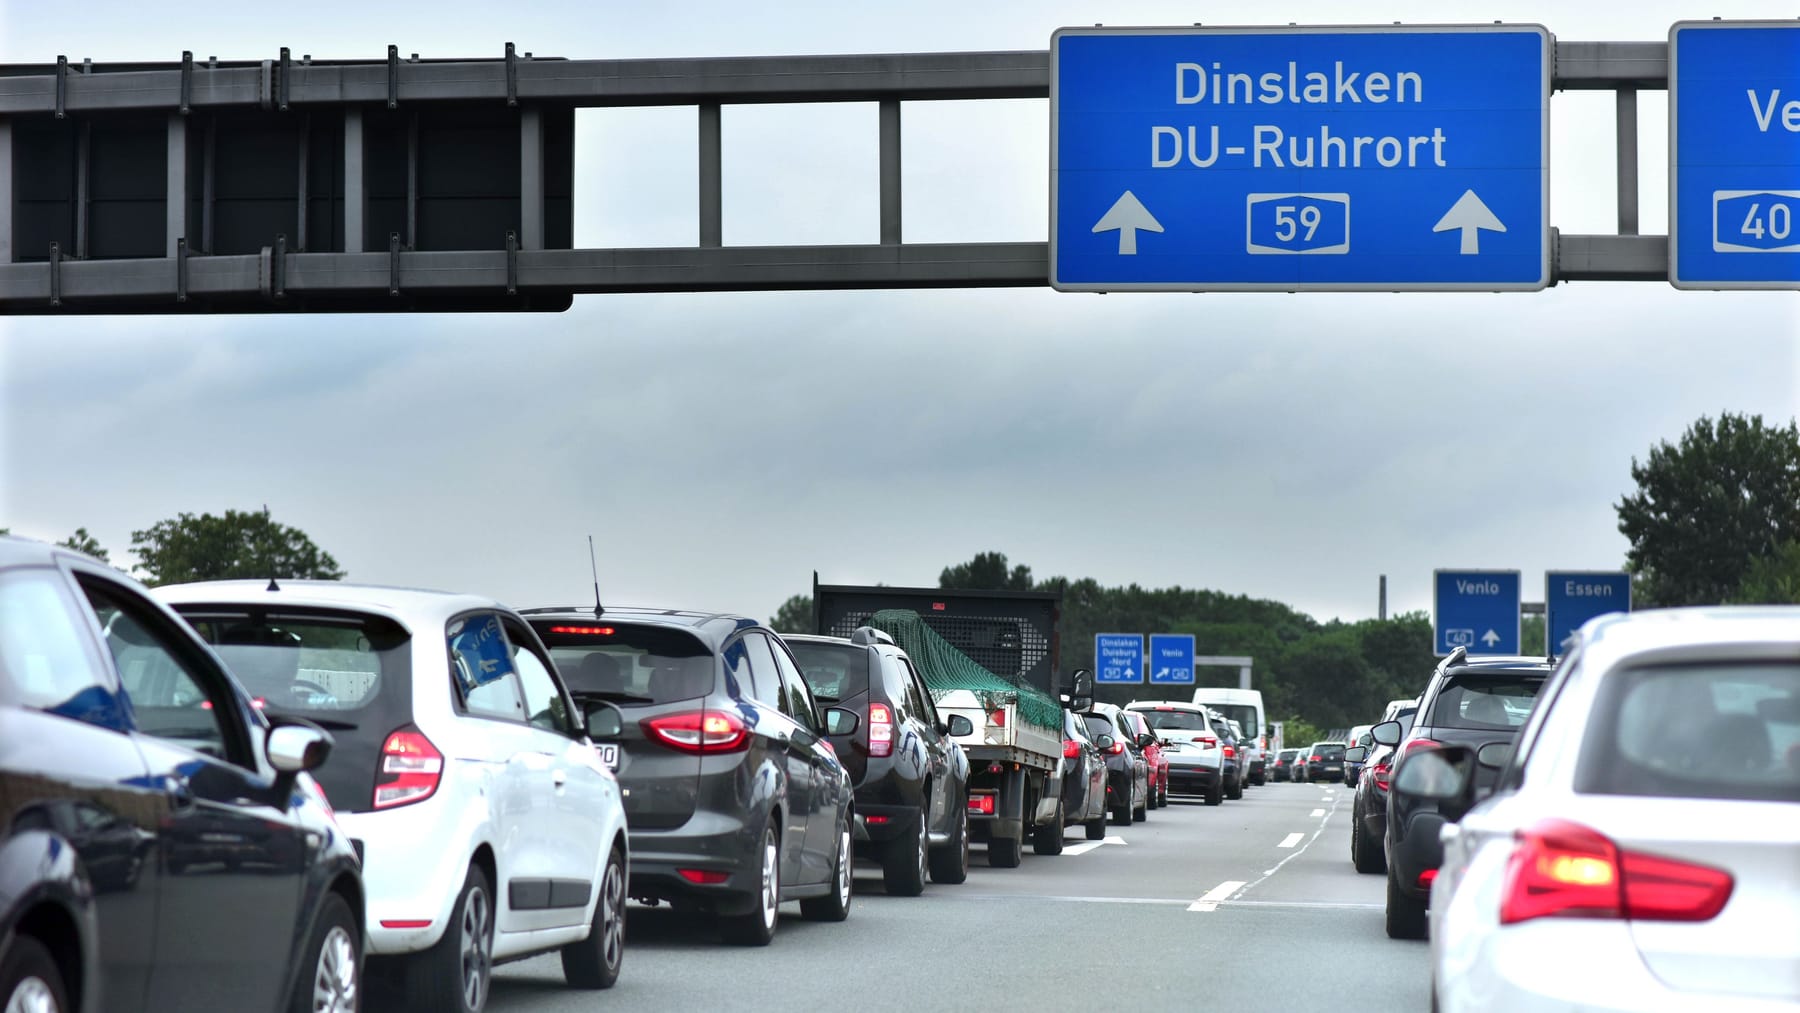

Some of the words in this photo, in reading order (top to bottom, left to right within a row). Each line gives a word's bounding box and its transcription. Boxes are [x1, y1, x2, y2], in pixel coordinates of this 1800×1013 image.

[1175, 61, 1422, 105] Dinslaken
[1151, 125, 1446, 168] DU-Ruhrort
[1275, 205, 1321, 242] 59
[1741, 203, 1791, 240] 40
[1456, 580, 1499, 595] Venlo
[1565, 581, 1612, 596] Essen
[1101, 638, 1138, 647] Dinslaken
[1102, 648, 1137, 658] Duisburg
[1161, 649, 1184, 657] Venlo
